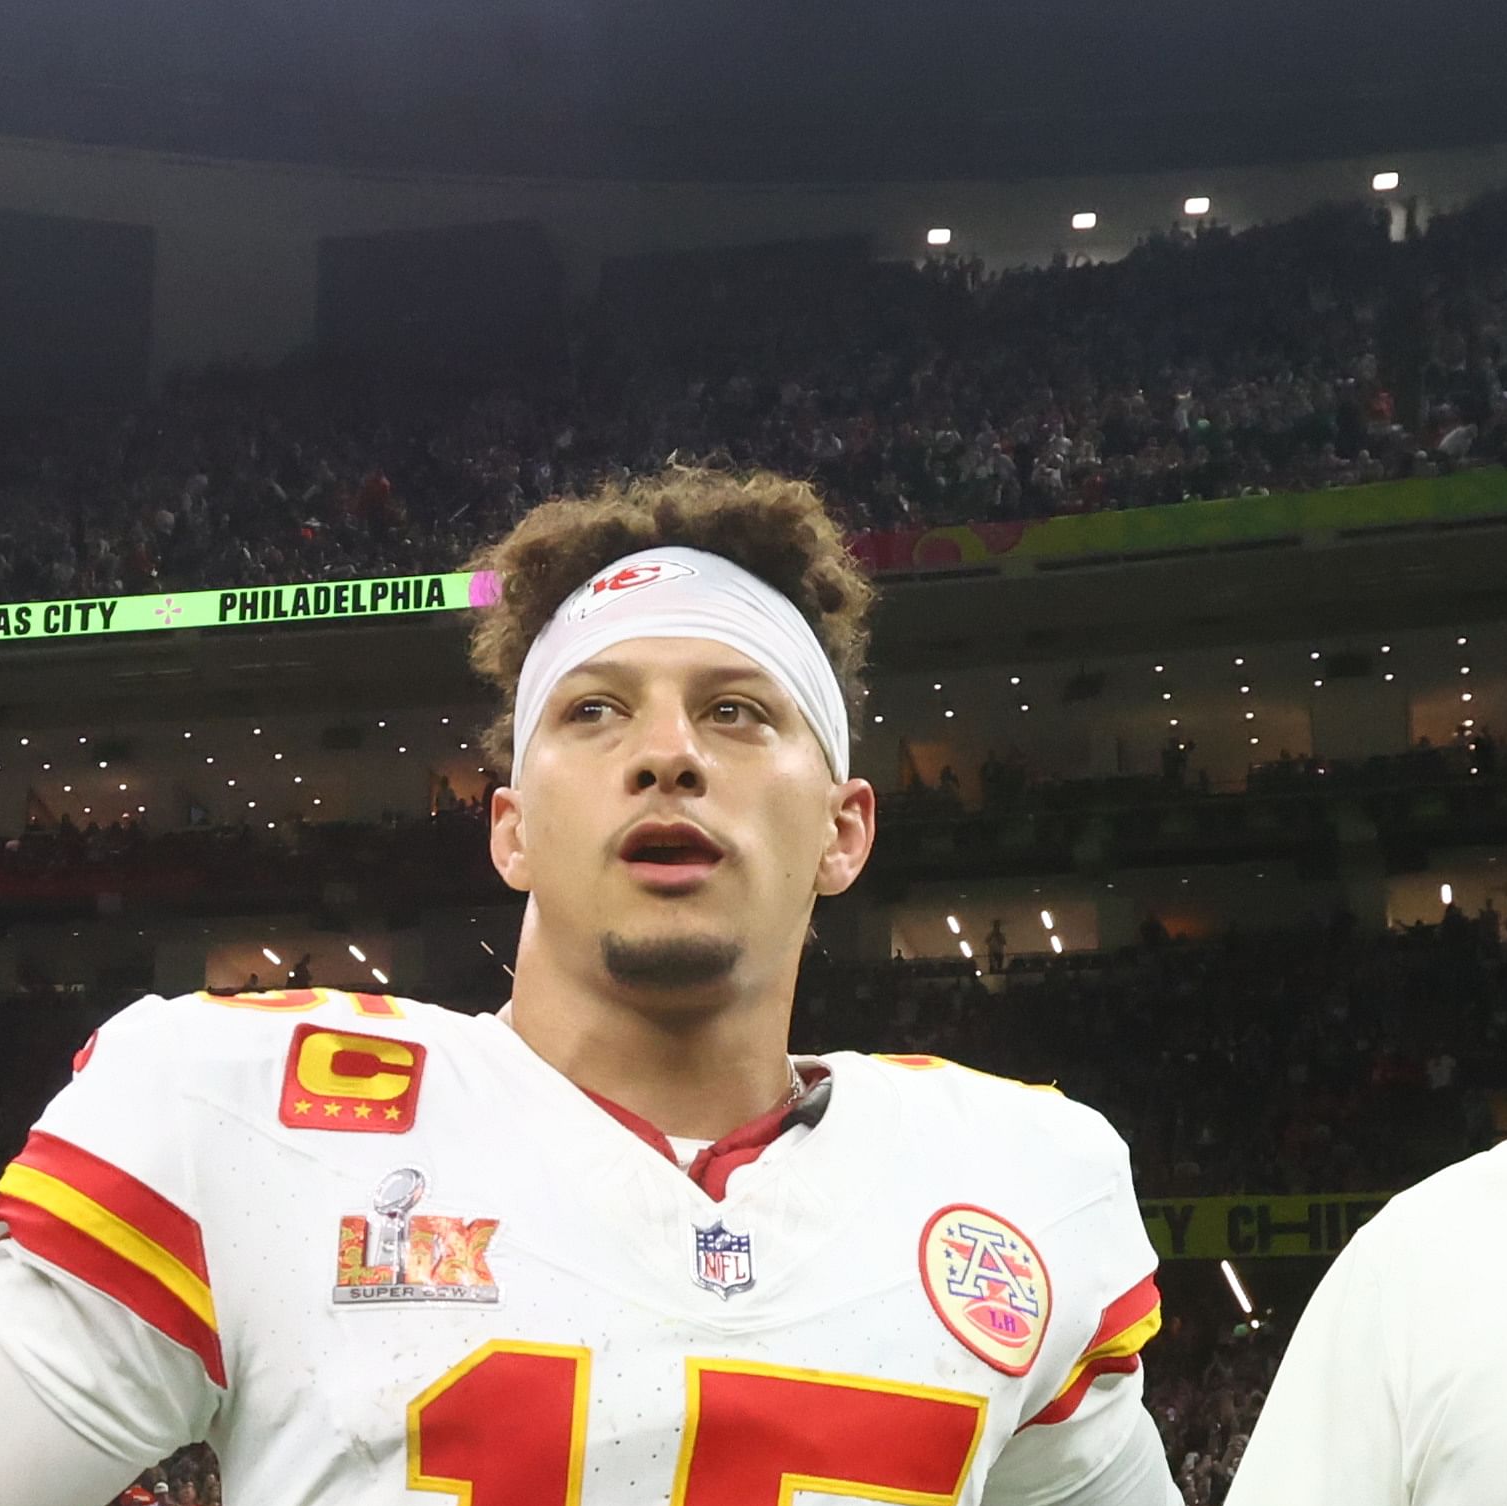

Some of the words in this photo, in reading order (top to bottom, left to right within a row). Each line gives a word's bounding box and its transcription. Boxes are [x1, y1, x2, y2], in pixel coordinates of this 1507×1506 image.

[44, 600, 118, 634] CITY
[218, 577, 446, 623] PHILADELPHIA
[297, 1032, 415, 1102] C
[350, 1287, 415, 1299] SUPER
[700, 1251, 748, 1283] NFL
[948, 1223, 1040, 1318] A
